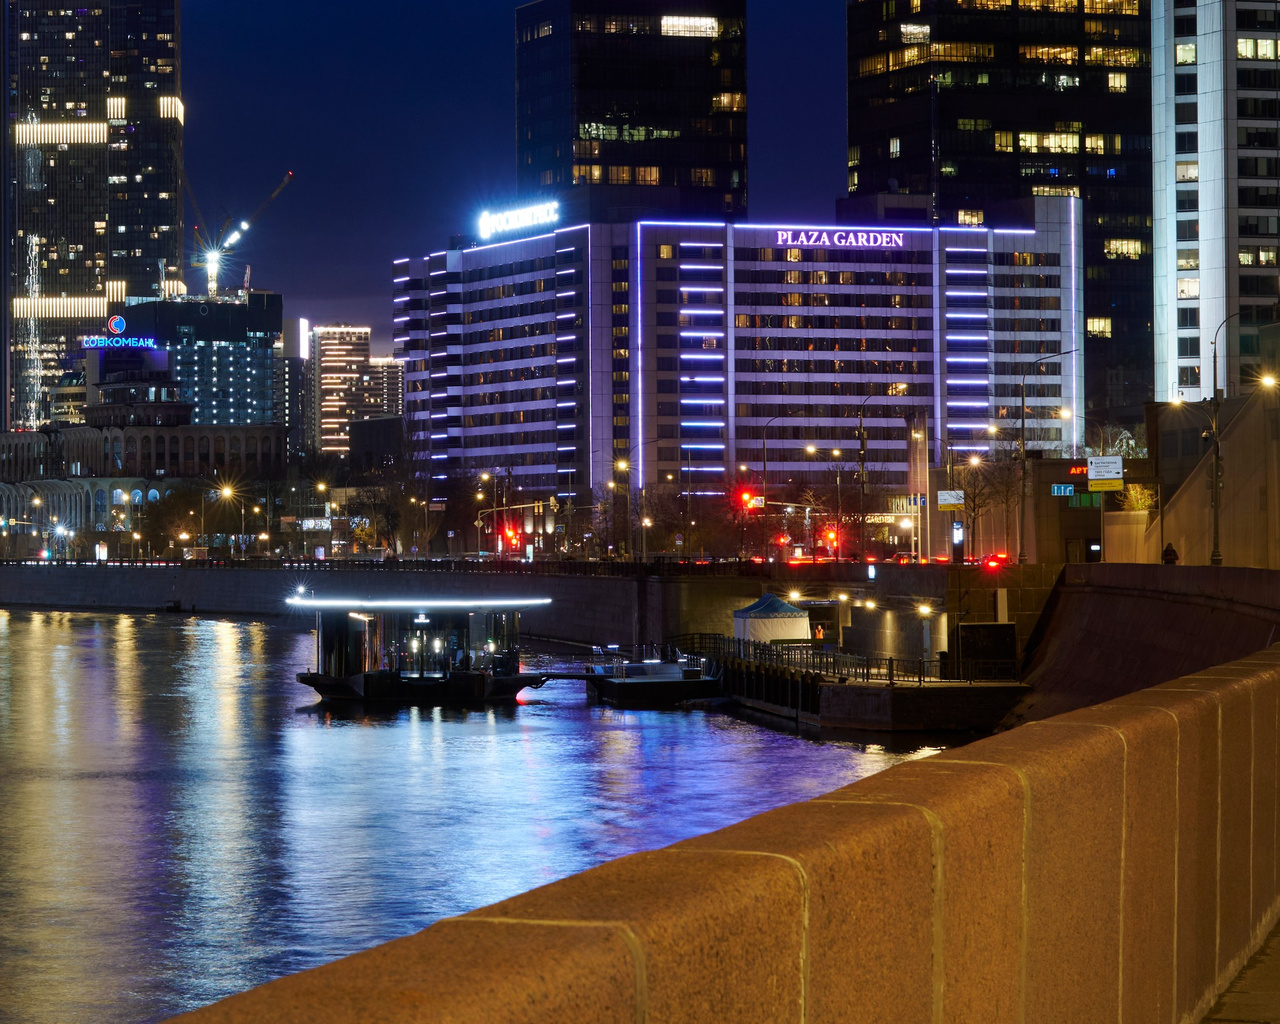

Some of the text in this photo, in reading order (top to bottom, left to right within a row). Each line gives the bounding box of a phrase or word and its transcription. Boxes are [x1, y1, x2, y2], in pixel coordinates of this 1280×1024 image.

[777, 231, 904, 247] PLAZA GARDEN
[83, 337, 155, 348] СОВКОМБАНК
[865, 515, 895, 524] GARDEN
